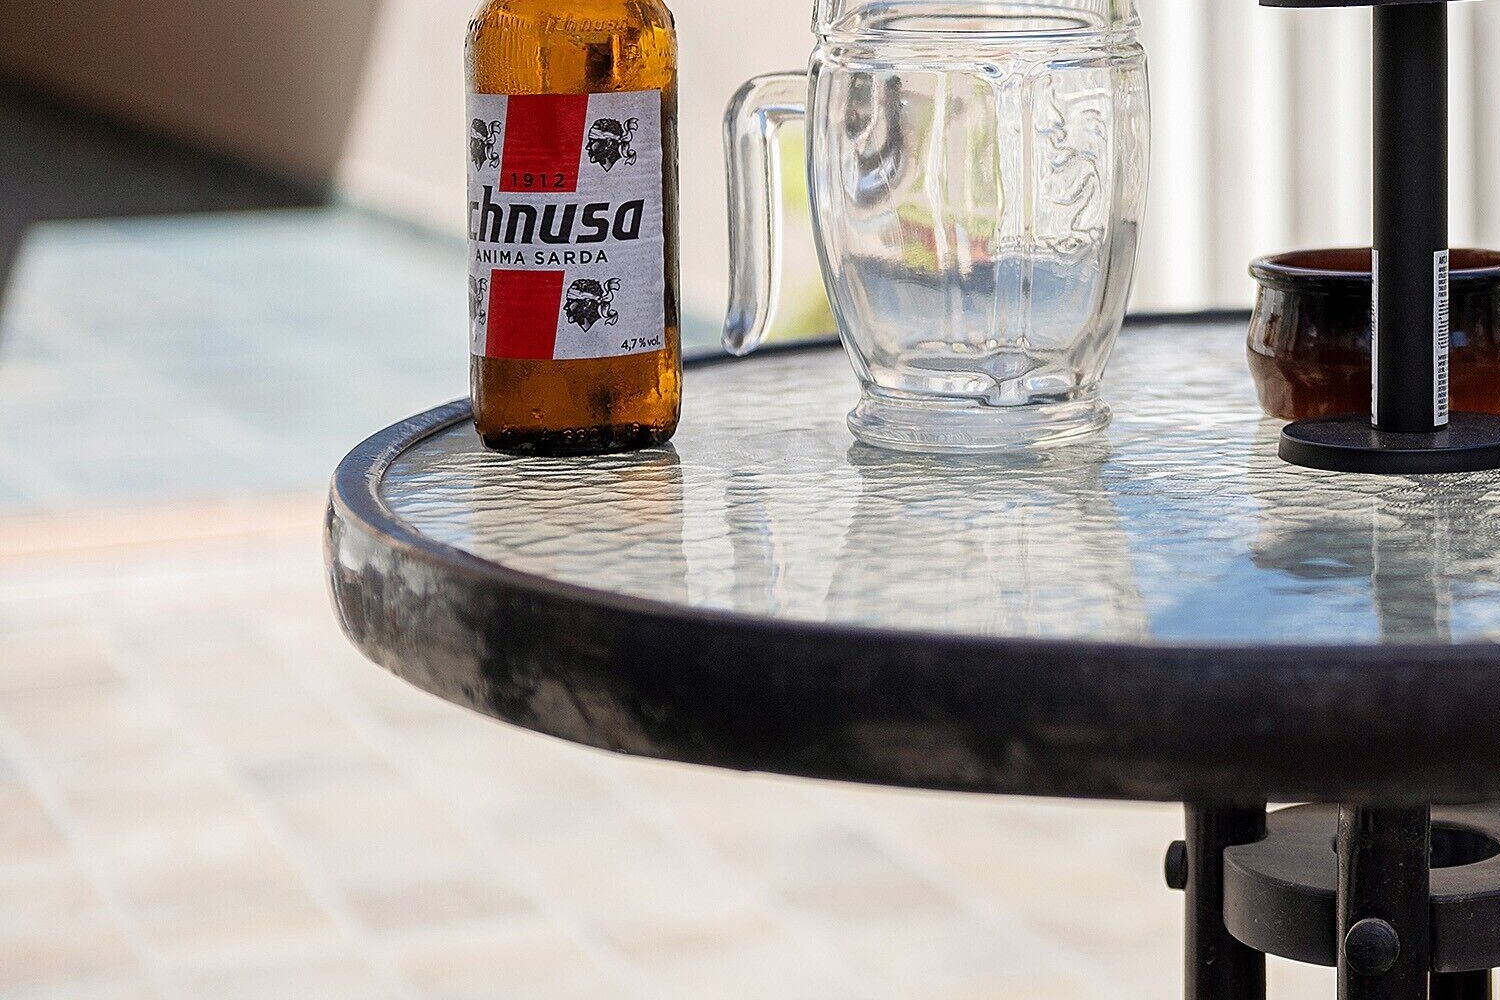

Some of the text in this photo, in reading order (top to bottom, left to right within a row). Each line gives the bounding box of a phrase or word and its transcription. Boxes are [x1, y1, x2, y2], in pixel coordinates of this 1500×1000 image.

[511, 173, 566, 188] 1912
[467, 184, 645, 245] chnusa
[475, 248, 609, 265] ANIMA SARDA
